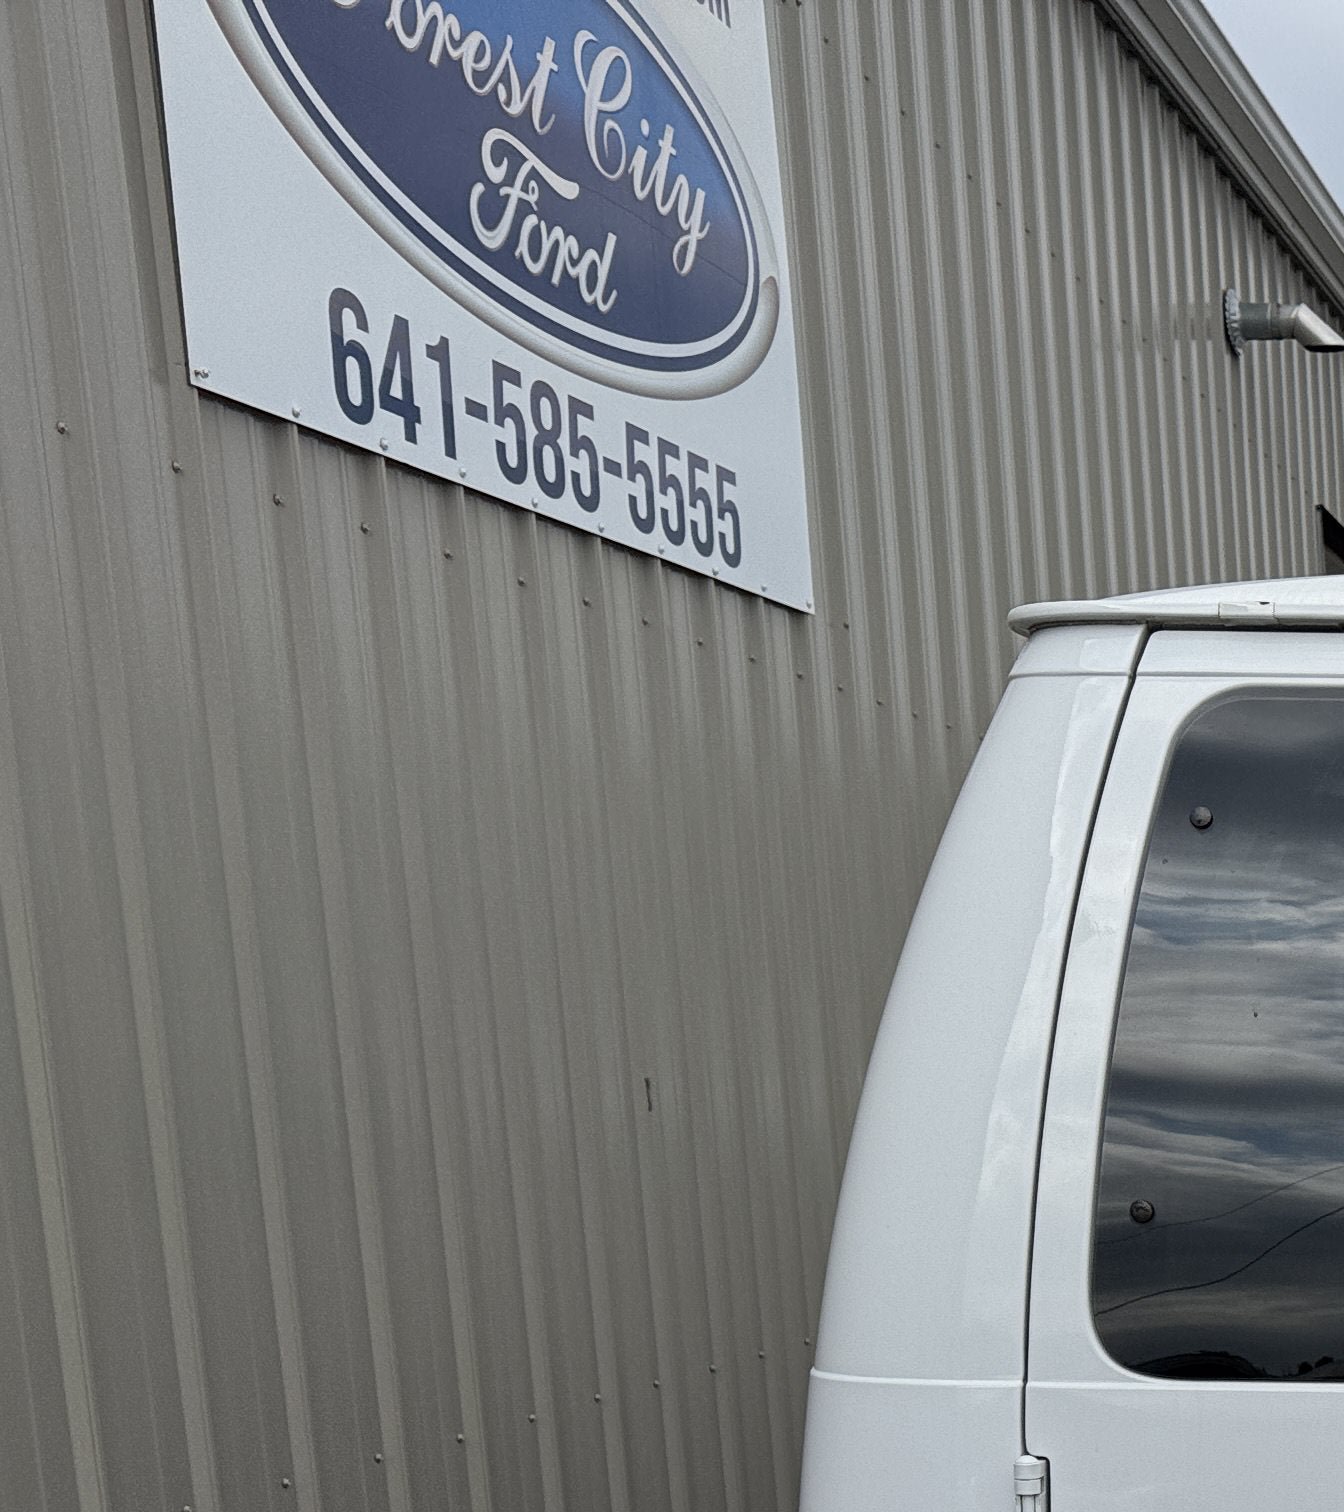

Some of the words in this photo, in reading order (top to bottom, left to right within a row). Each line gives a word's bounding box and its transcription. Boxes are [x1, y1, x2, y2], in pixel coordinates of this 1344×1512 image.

[333, 0, 559, 135] orest
[574, 29, 711, 276] City
[469, 127, 619, 314] Ford
[328, 287, 743, 569] 641-585-5555
